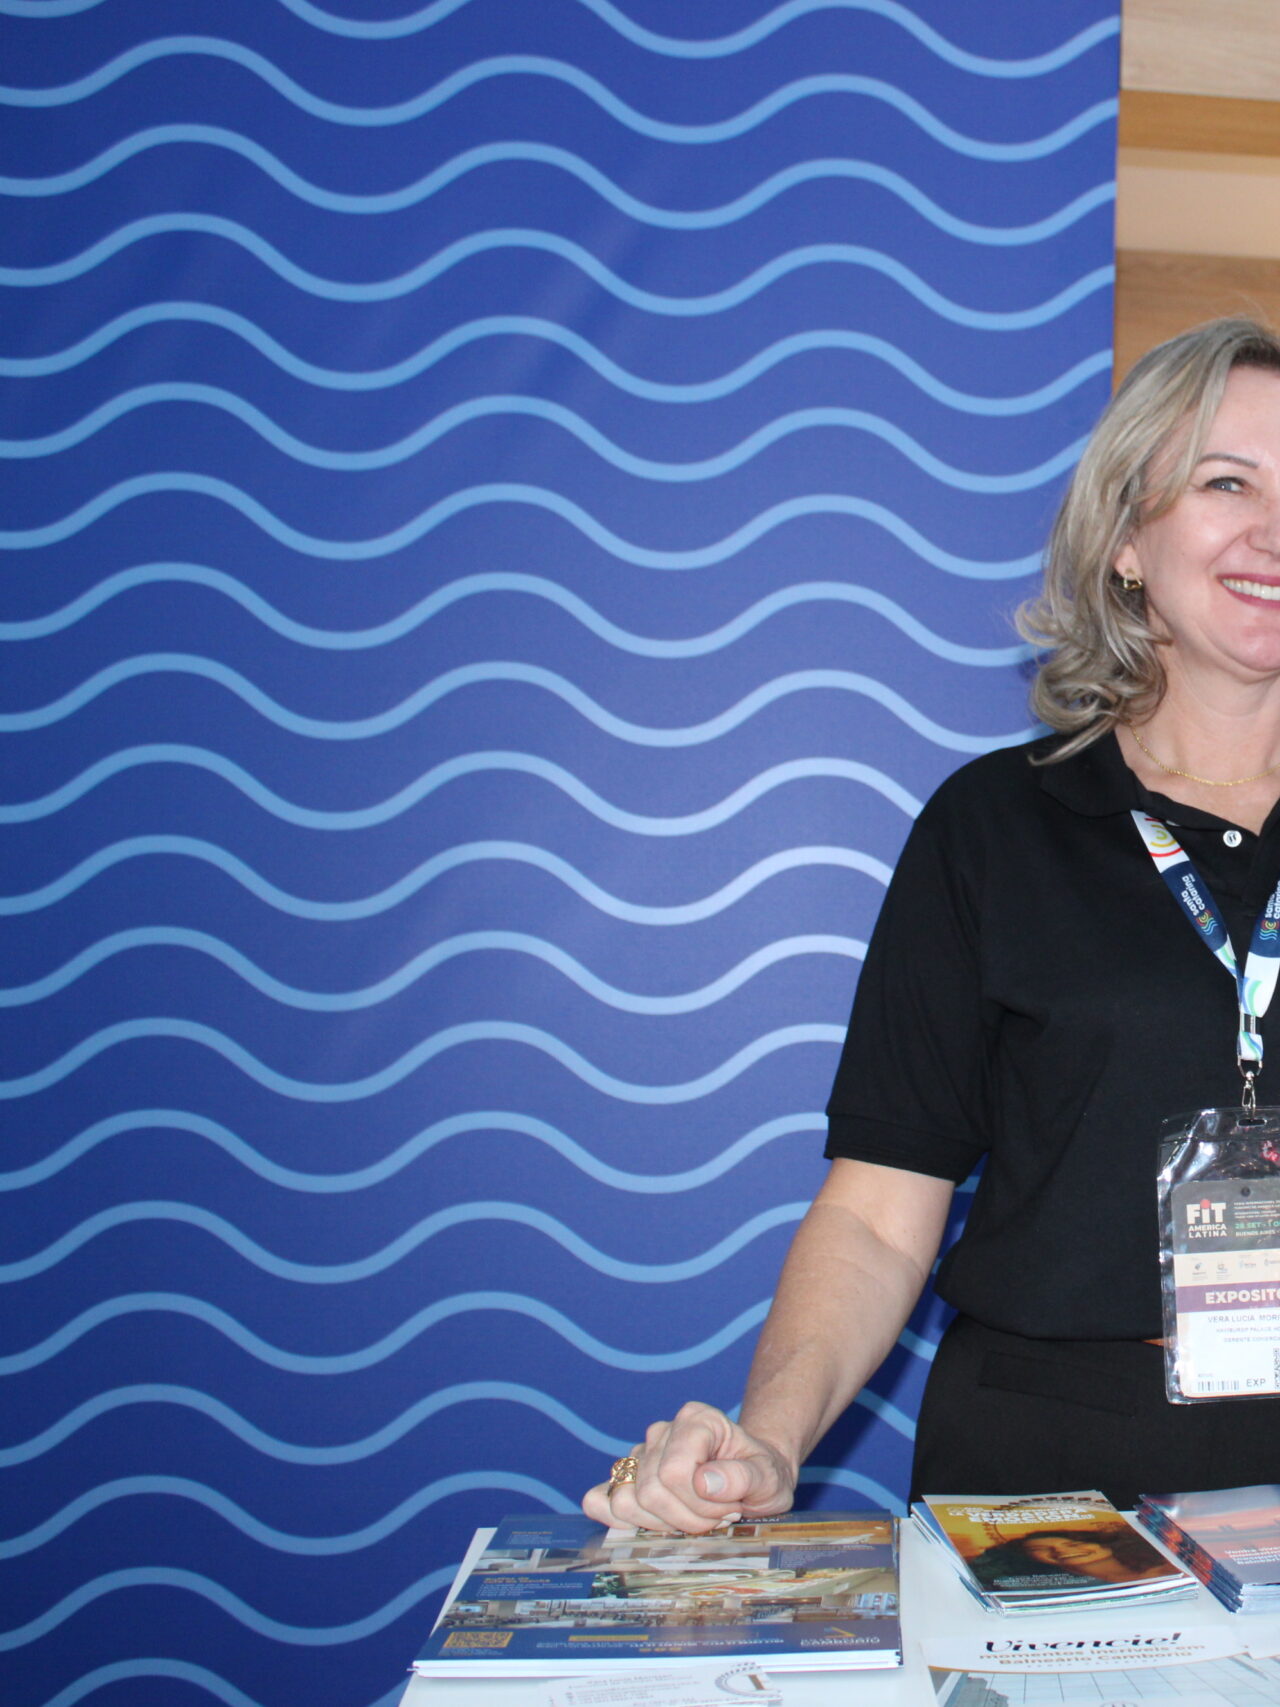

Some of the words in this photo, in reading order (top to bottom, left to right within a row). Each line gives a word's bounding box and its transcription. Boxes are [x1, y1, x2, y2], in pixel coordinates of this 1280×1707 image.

[1182, 875, 1205, 911] catarina
[1181, 890, 1199, 915] santa
[1188, 1223, 1228, 1232] AMERICA
[1188, 1230, 1228, 1239] LATINA
[1208, 1315, 1230, 1323] VERA
[1232, 1314, 1255, 1322] LUCIA
[1246, 1378, 1266, 1387] EXP
[985, 1632, 1182, 1652] Vivencie!
[979, 1650, 1084, 1660] momentos
